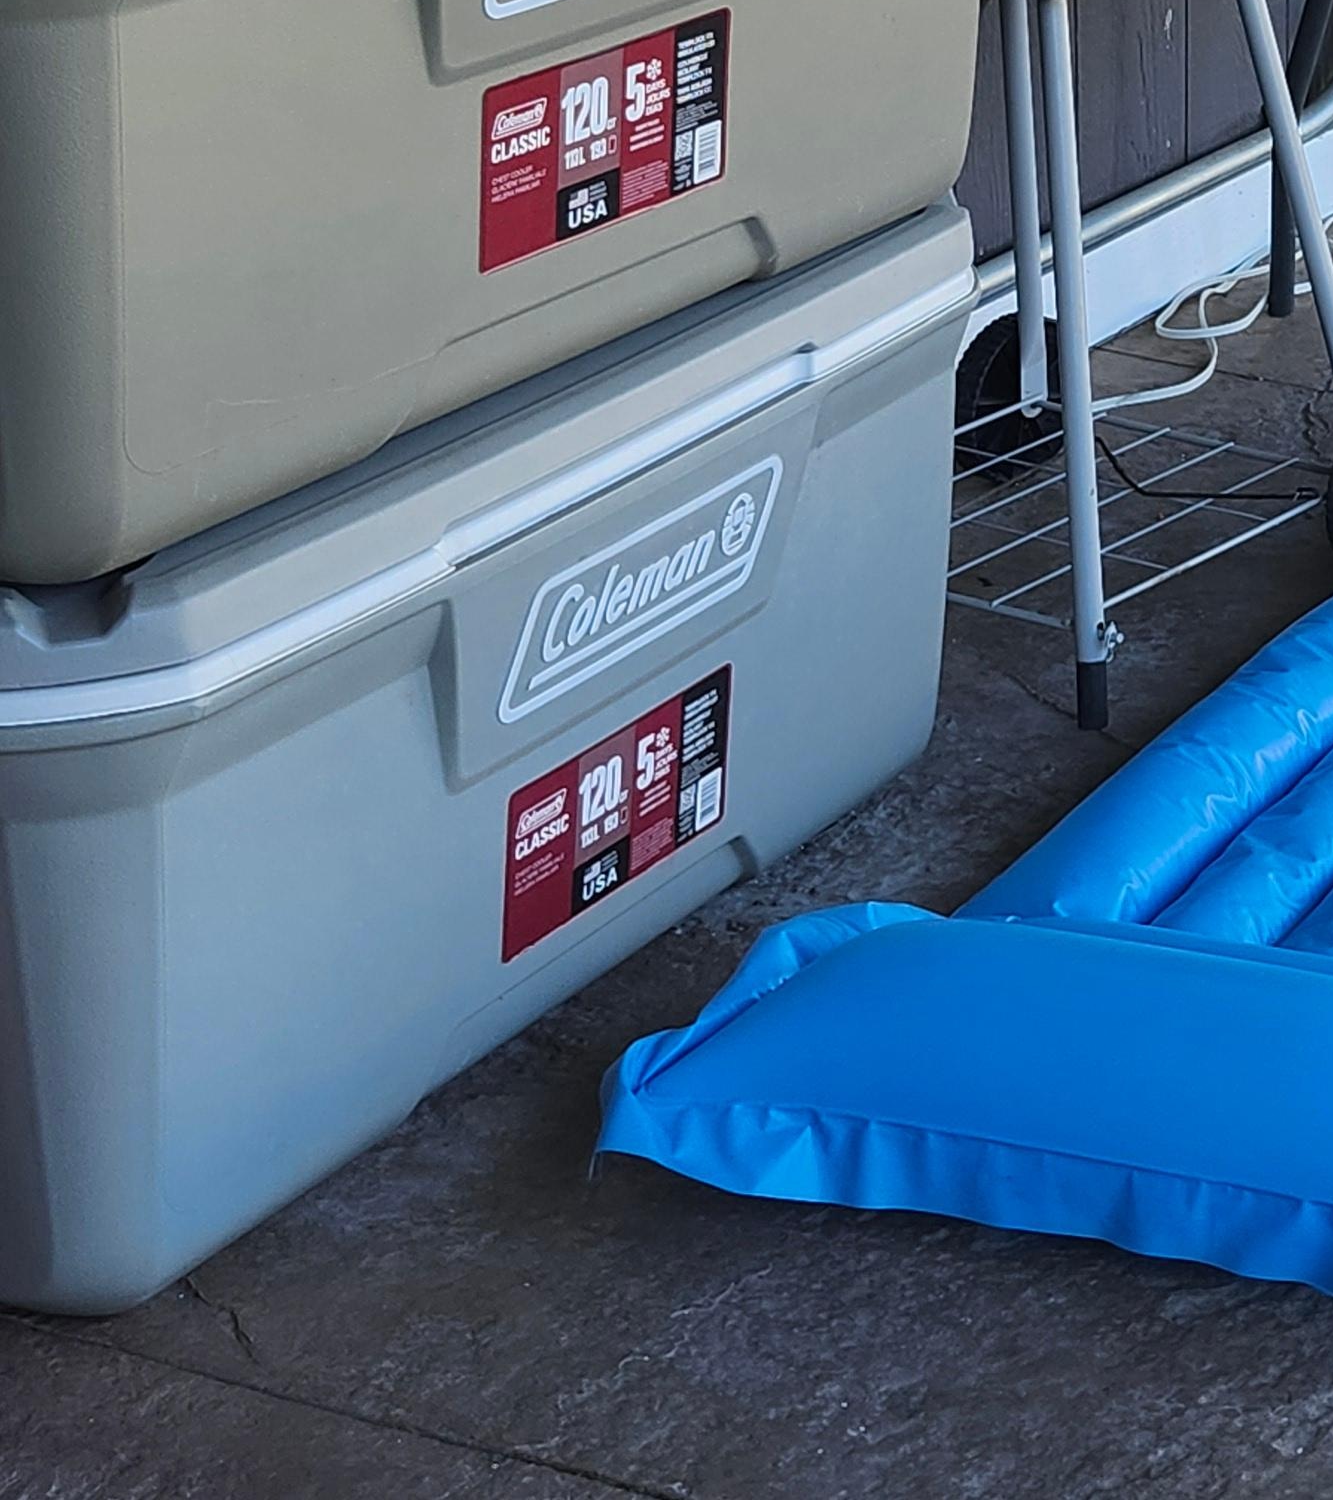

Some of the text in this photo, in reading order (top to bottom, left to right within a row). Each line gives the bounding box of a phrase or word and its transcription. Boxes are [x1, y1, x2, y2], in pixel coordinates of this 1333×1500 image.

[561, 76, 609, 146] 120
[625, 61, 646, 122] 5
[491, 125, 551, 164] CLASSIC
[568, 198, 609, 229] USA
[543, 530, 715, 662] Coleman
[578, 755, 622, 827] 120
[636, 732, 656, 791] 5
[515, 813, 570, 861] CLASSIC
[582, 867, 618, 901] USA
